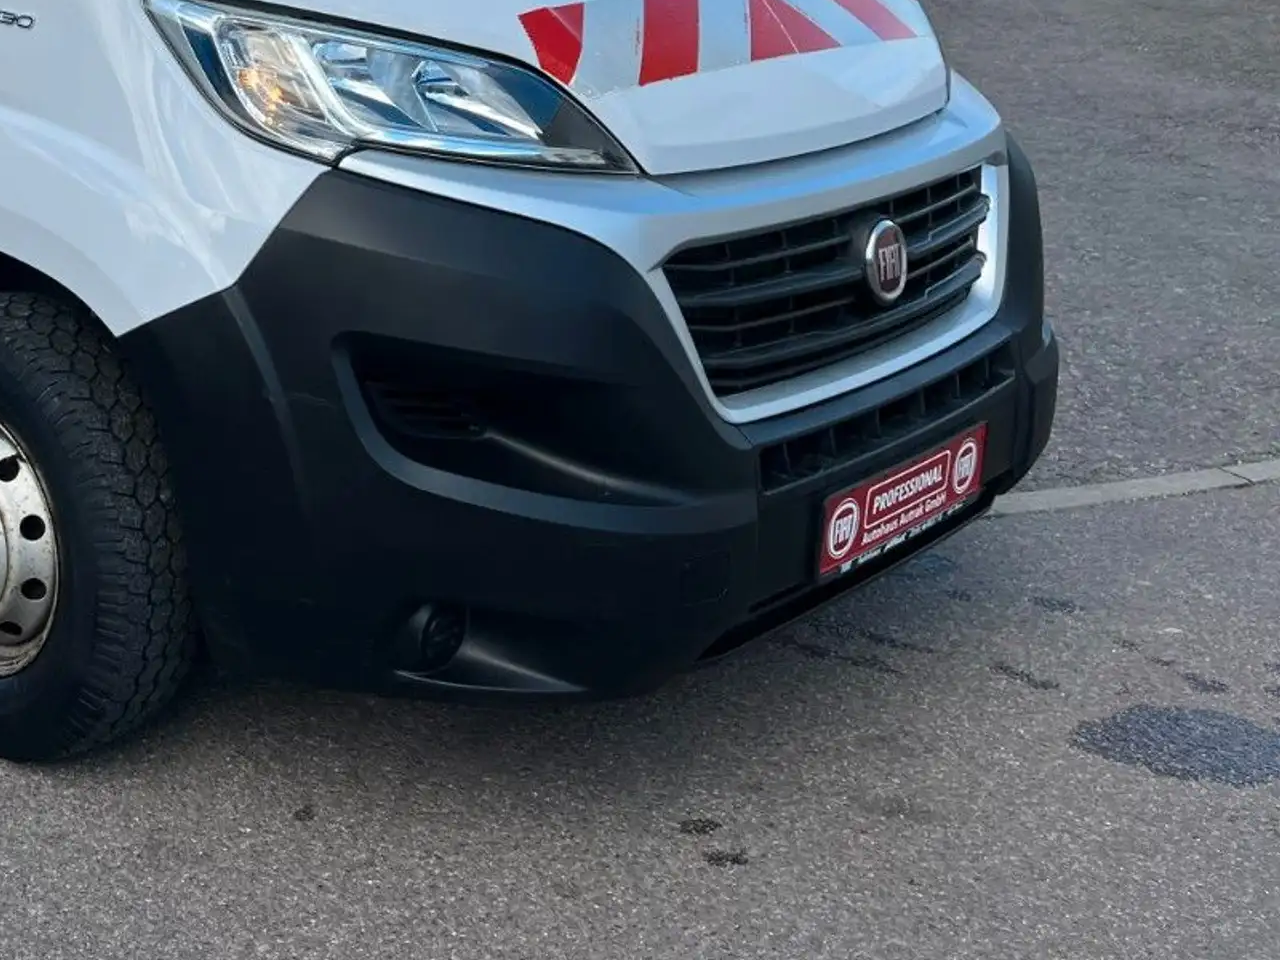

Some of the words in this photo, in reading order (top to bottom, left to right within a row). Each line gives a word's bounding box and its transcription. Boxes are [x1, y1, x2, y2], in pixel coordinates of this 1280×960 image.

[878, 243, 901, 282] FIAT
[872, 464, 942, 515] PROFESSIONAL
[924, 490, 947, 513] GmbH
[833, 513, 853, 545] FIAT
